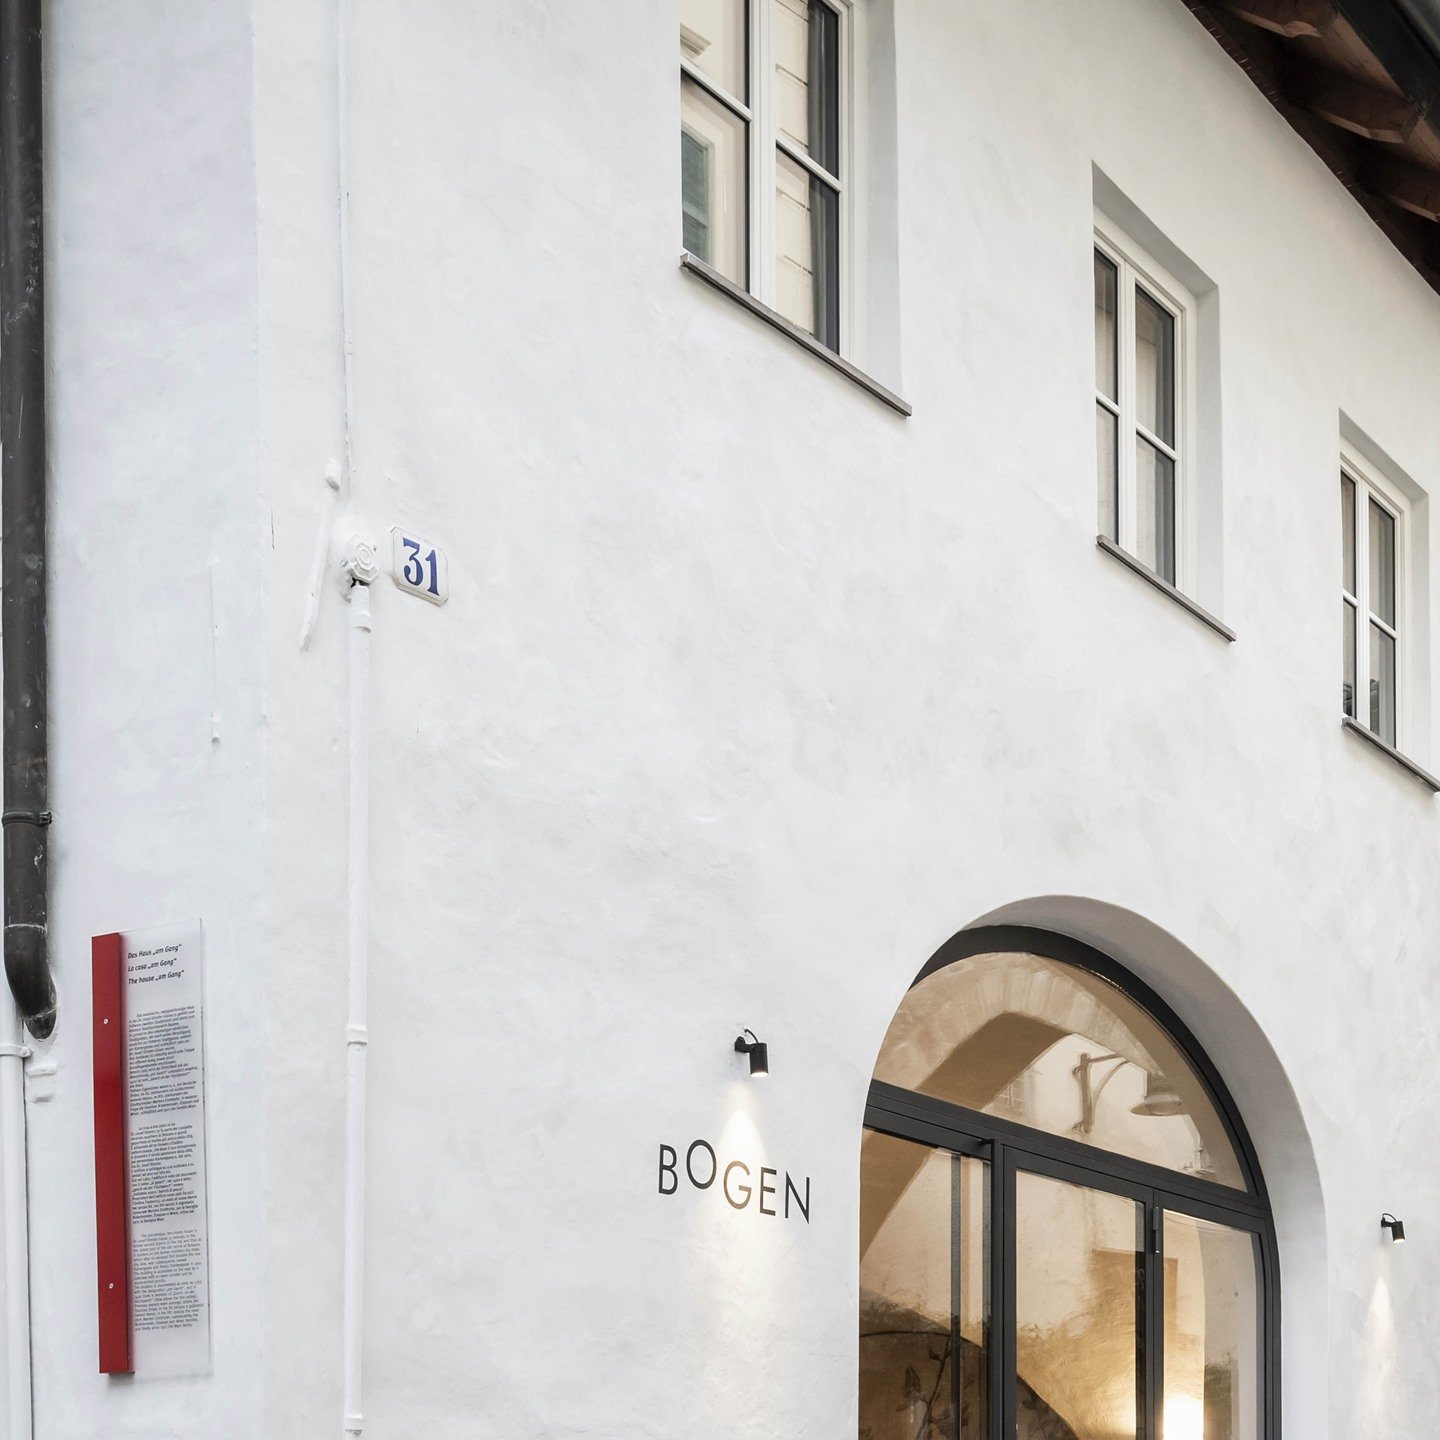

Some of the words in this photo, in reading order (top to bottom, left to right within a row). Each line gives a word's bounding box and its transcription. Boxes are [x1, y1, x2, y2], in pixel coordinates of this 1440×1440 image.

[402, 536, 440, 596] 31
[138, 949, 152, 957] Haus
[135, 963, 147, 971] casa
[128, 977, 138, 985] The
[138, 975, 155, 983] house
[658, 1139, 810, 1224] BOGEN
